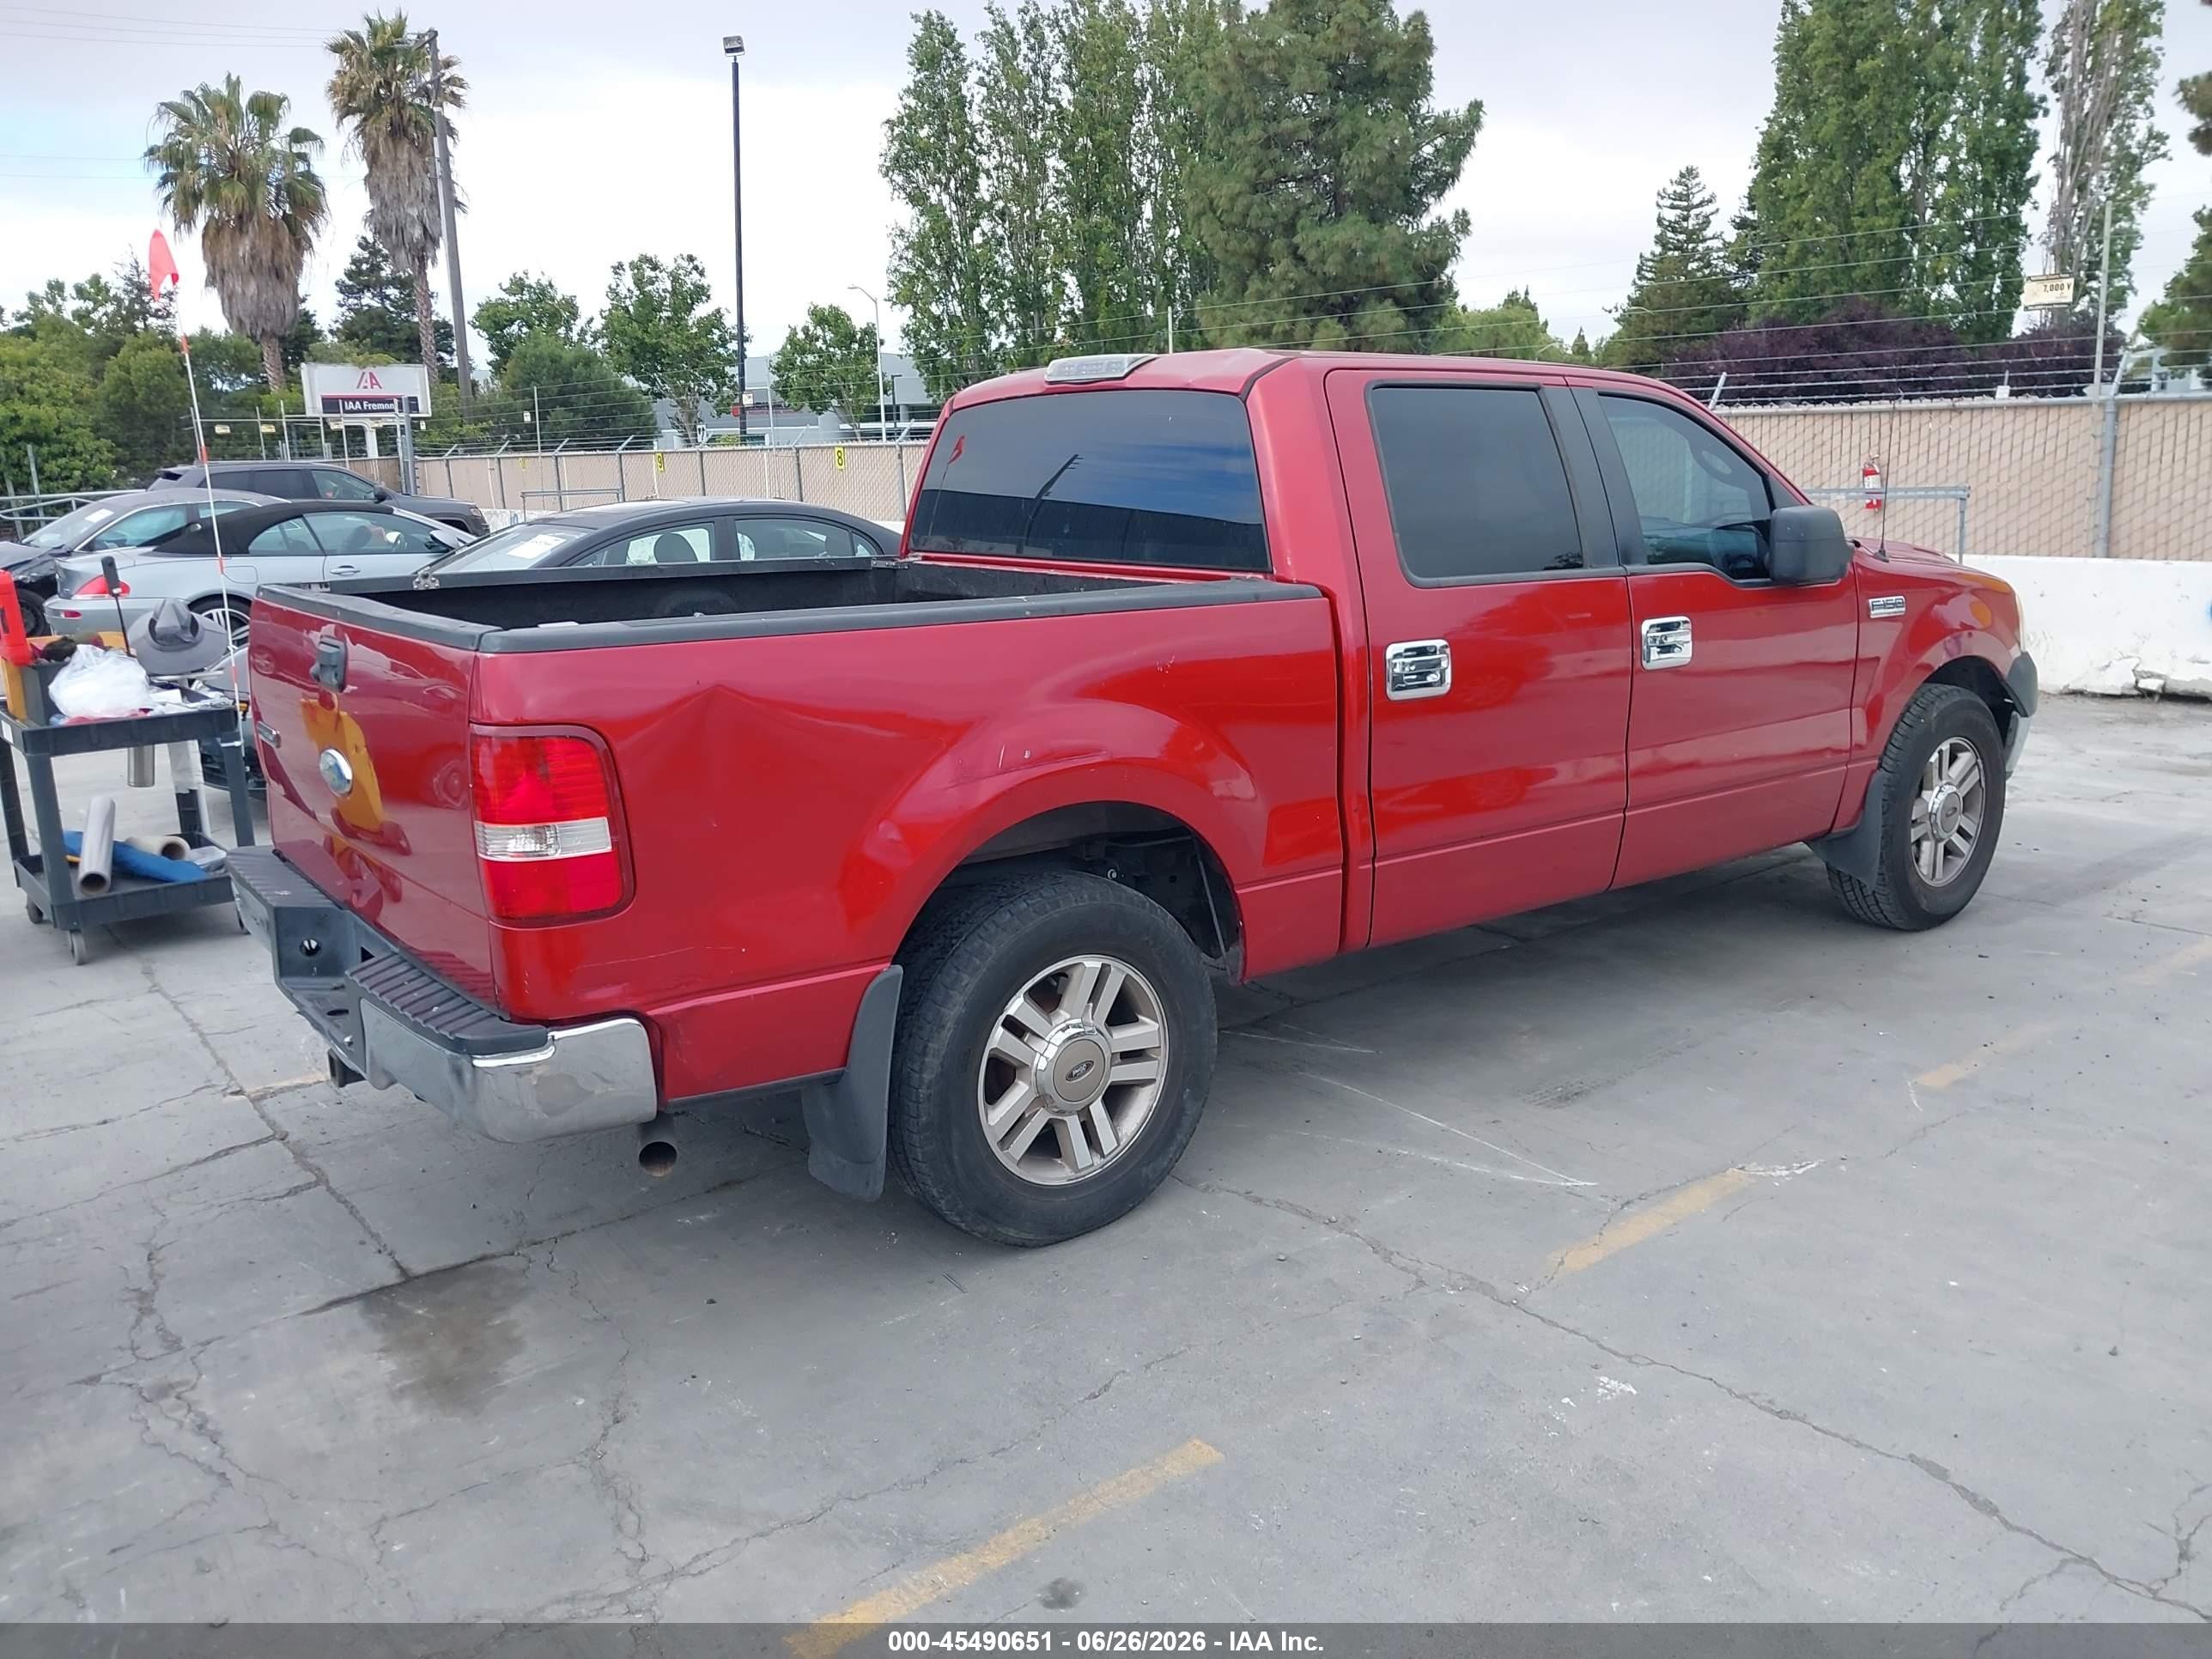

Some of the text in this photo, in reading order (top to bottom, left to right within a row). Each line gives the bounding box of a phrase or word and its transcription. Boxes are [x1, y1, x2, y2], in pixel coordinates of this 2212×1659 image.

[2043, 283, 2064, 293] 7,000
[344, 400, 398, 410] IAA Fremon
[836, 449, 843, 466] 8
